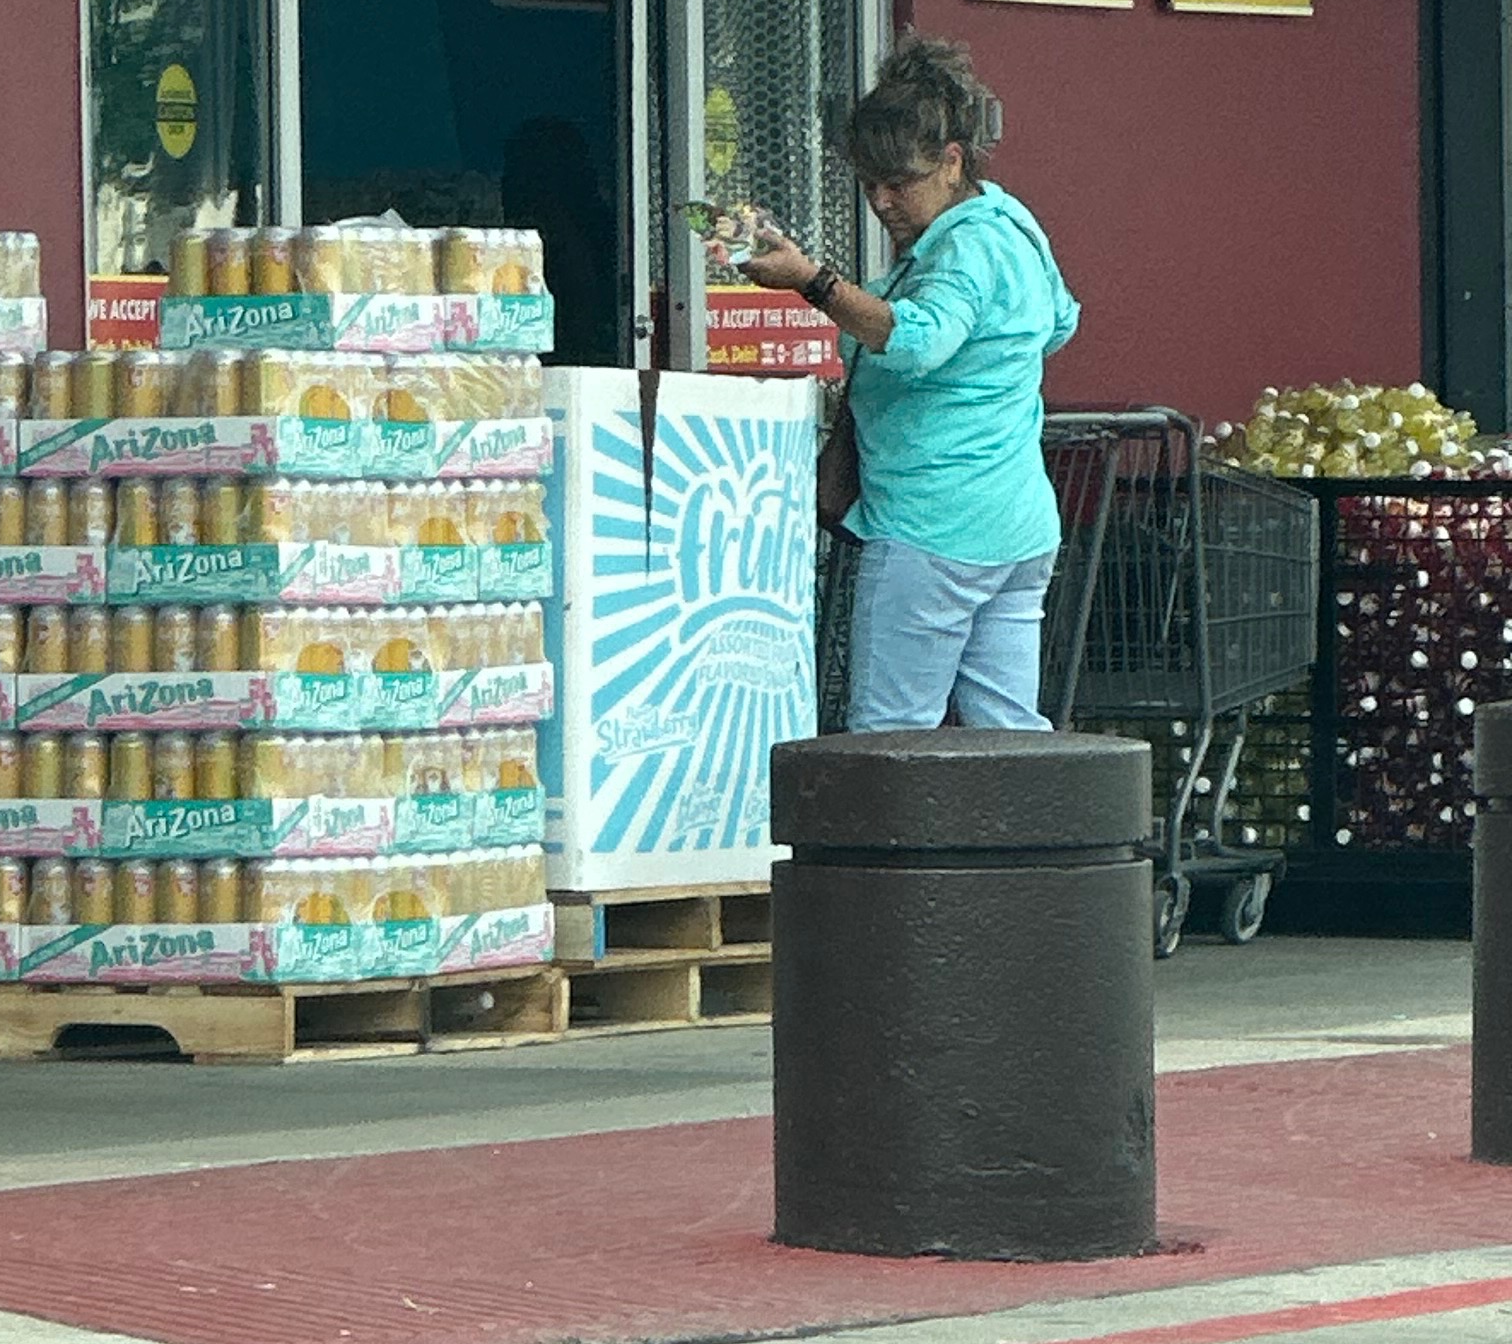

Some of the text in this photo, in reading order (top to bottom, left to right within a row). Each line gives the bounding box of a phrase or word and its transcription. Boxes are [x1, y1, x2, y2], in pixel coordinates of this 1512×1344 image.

[88, 298, 156, 321] WE ACCEPT
[187, 300, 294, 348] AriZona
[722, 308, 762, 328] ACCEPT
[89, 421, 217, 472] AriZona
[137, 548, 244, 592] AriZona
[88, 677, 215, 725] AriZona
[124, 802, 237, 848] AriZona
[90, 929, 216, 976] AriZona
